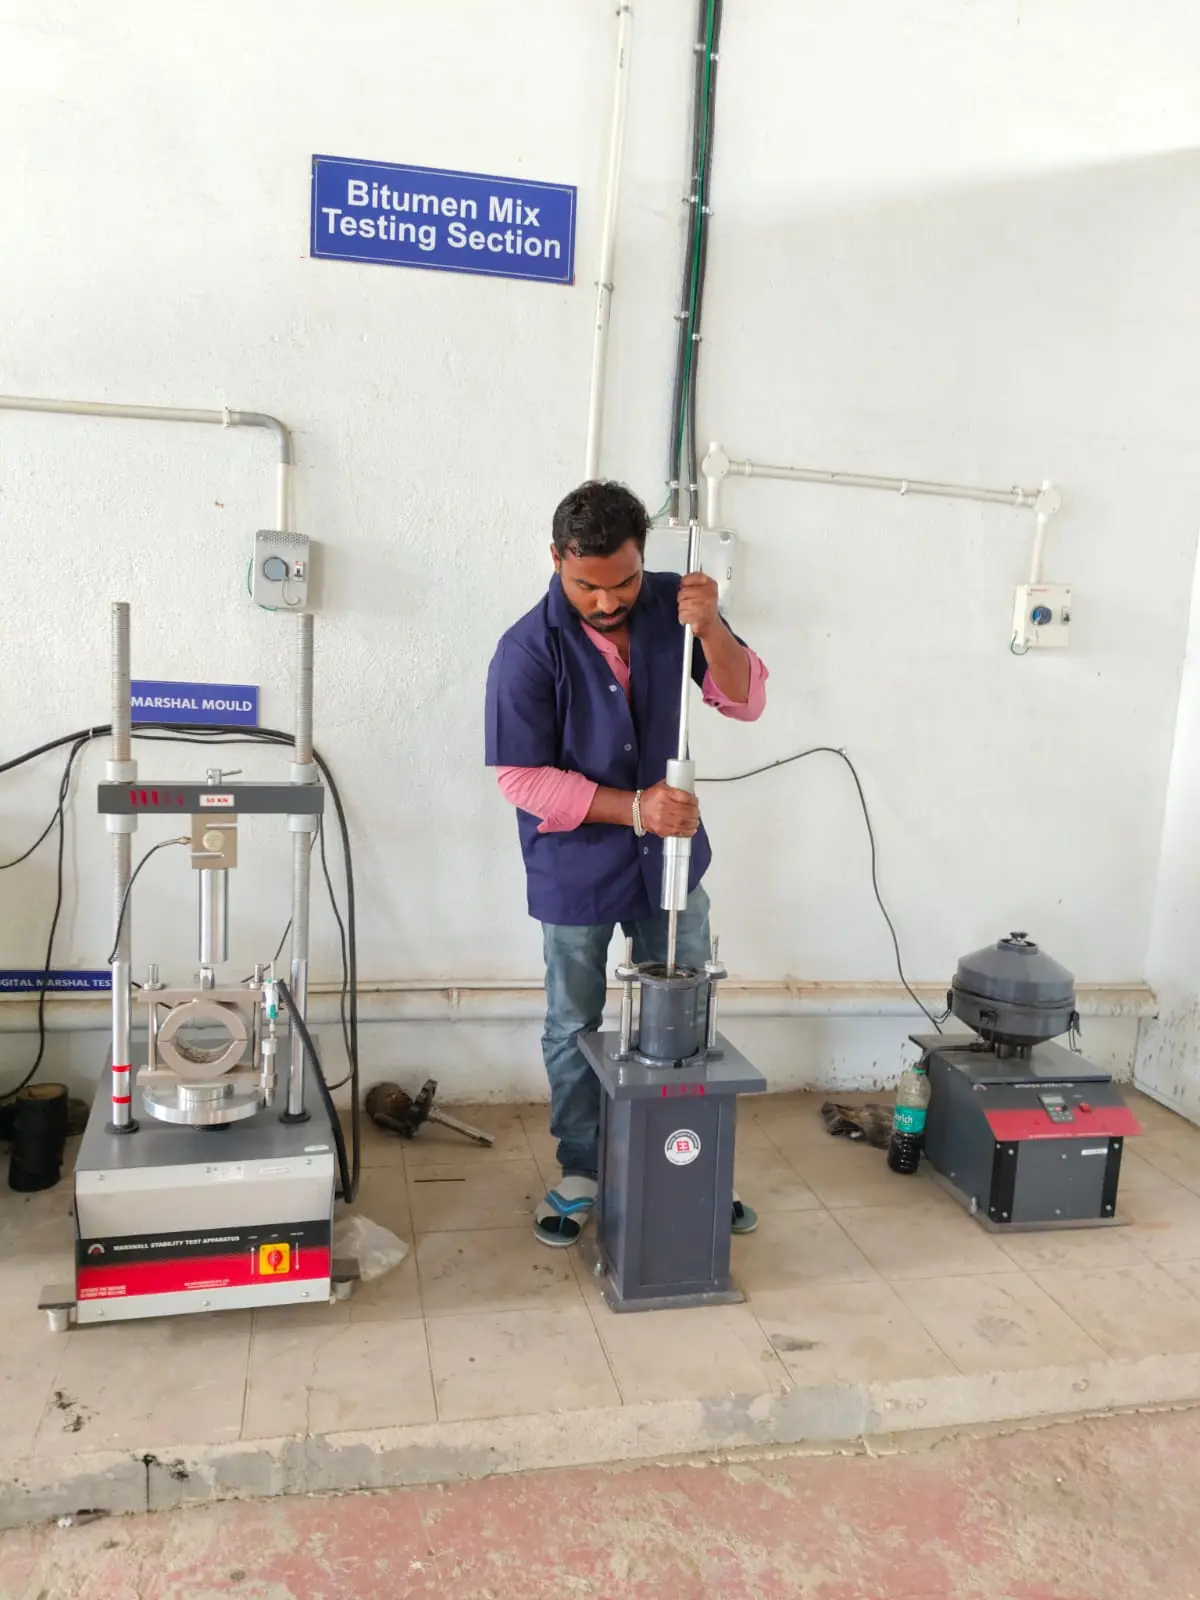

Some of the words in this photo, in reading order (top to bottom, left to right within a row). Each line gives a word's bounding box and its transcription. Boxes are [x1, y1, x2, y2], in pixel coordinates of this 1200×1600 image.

[347, 179, 477, 219] Bitumen
[488, 196, 541, 227] Mix
[321, 207, 437, 251] Testing
[447, 222, 561, 259] Section
[131, 696, 198, 709] MARSHAL
[202, 699, 252, 711] MOULD
[0, 978, 33, 987] GITAL
[92, 979, 112, 987] TES
[150, 1240, 184, 1248] STABILITY
